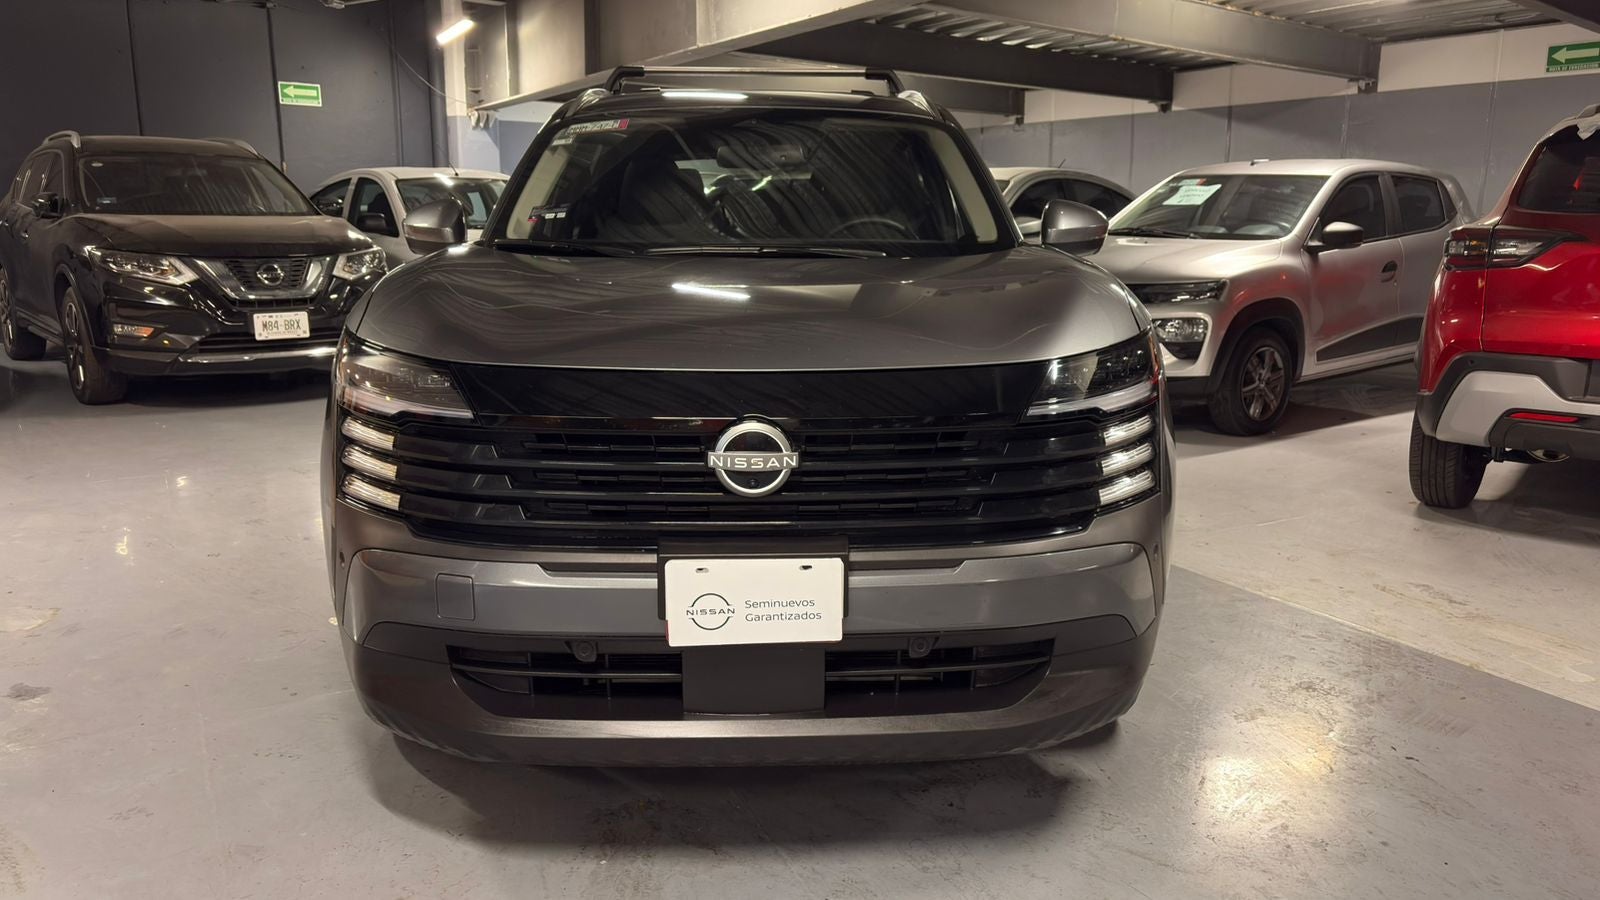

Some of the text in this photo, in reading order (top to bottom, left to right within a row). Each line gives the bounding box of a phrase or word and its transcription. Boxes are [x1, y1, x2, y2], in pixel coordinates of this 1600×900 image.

[710, 455, 797, 469] NISSAN
[744, 599, 815, 609] Seminuevos
[686, 608, 735, 616] NISSAN
[745, 611, 822, 622] Garantizados
